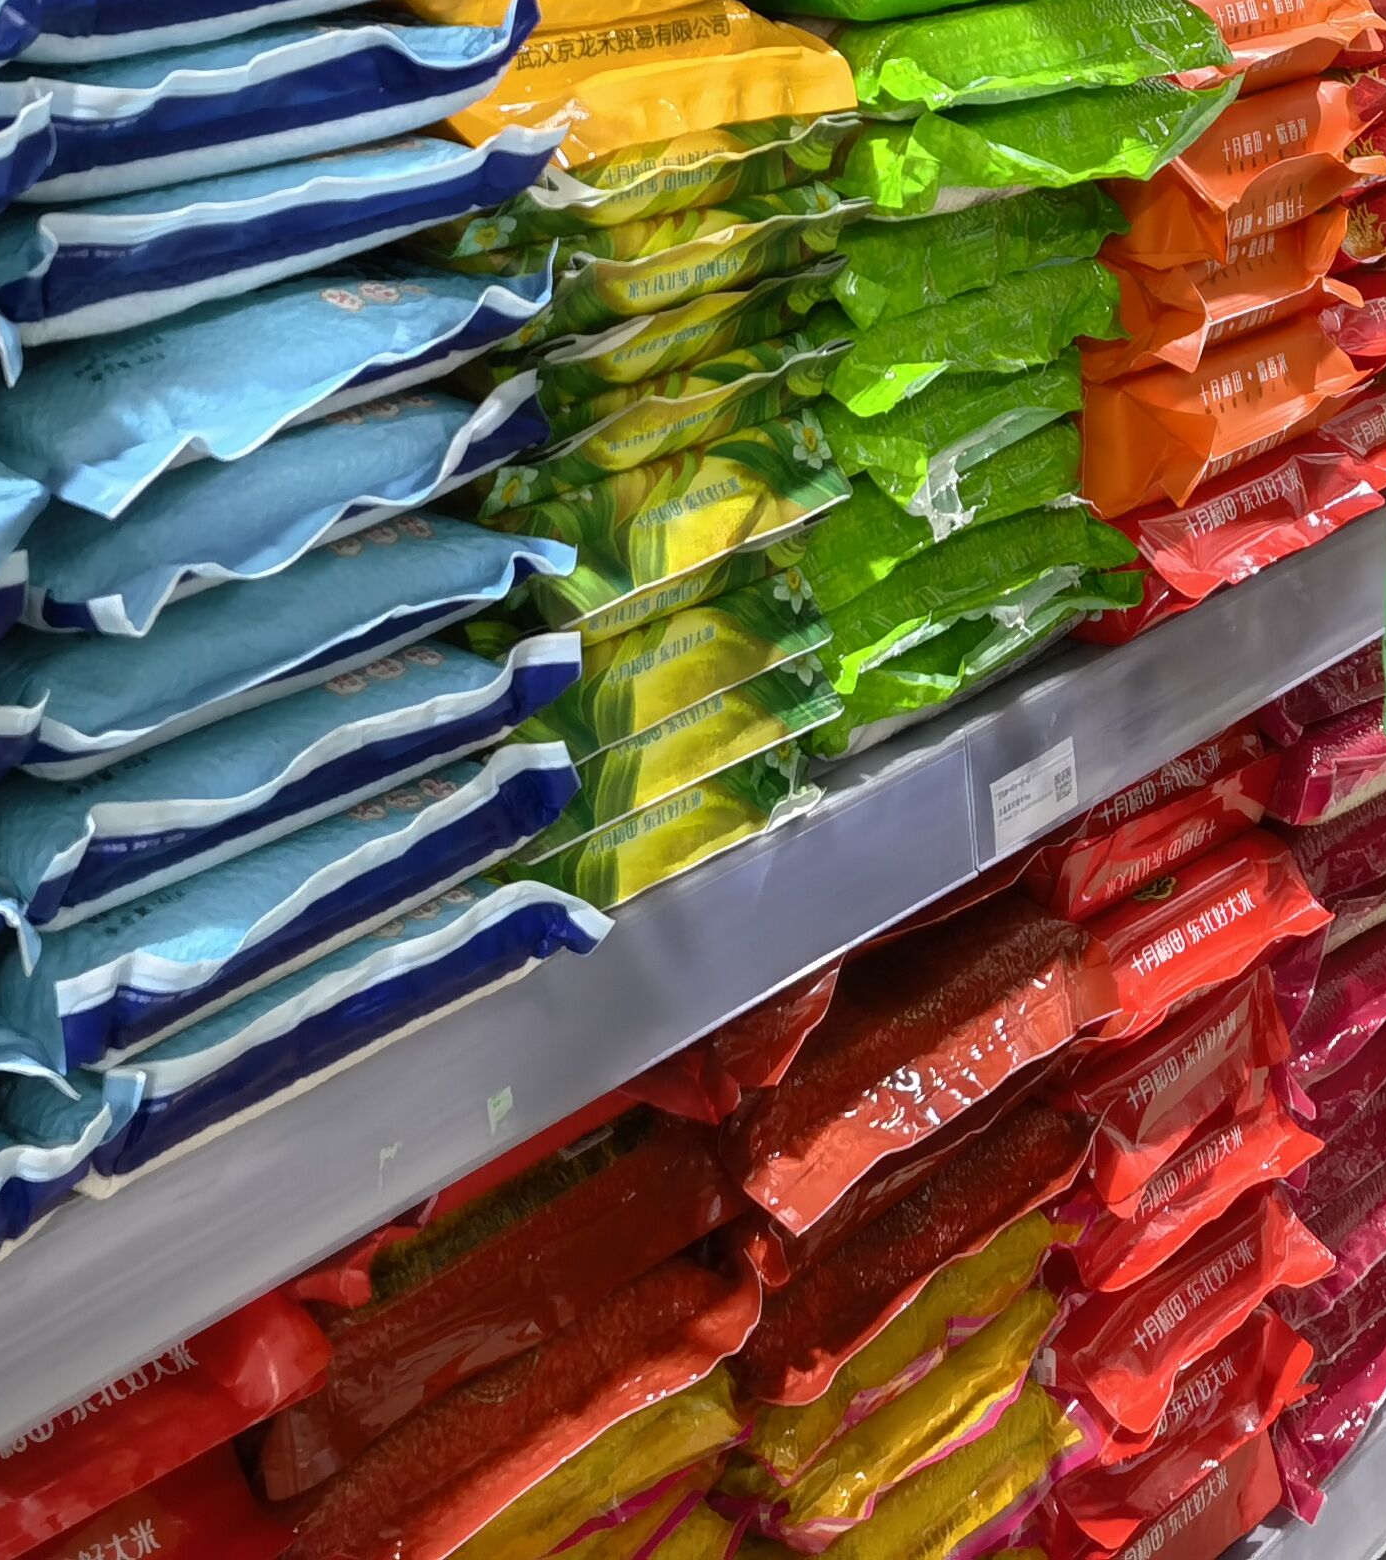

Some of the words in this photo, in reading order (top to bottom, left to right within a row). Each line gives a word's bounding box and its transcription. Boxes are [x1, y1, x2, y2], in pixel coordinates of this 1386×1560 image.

[516, 13, 732, 72] 武汉京龙禾贸易有限公司
[1239, 466, 1304, 512] 东北好大米
[1130, 927, 1185, 977] 十月稻田
[1187, 888, 1256, 945] 东北好大米
[1126, 1054, 1181, 1111] 十月稻田
[1181, 1011, 1239, 1072] 东北好大米
[1181, 1124, 1245, 1186] 东北好大米
[1131, 1293, 1187, 1352] 十月稻田
[1188, 1237, 1256, 1308] 东北好大米
[1168, 1355, 1239, 1424] 东北好大米
